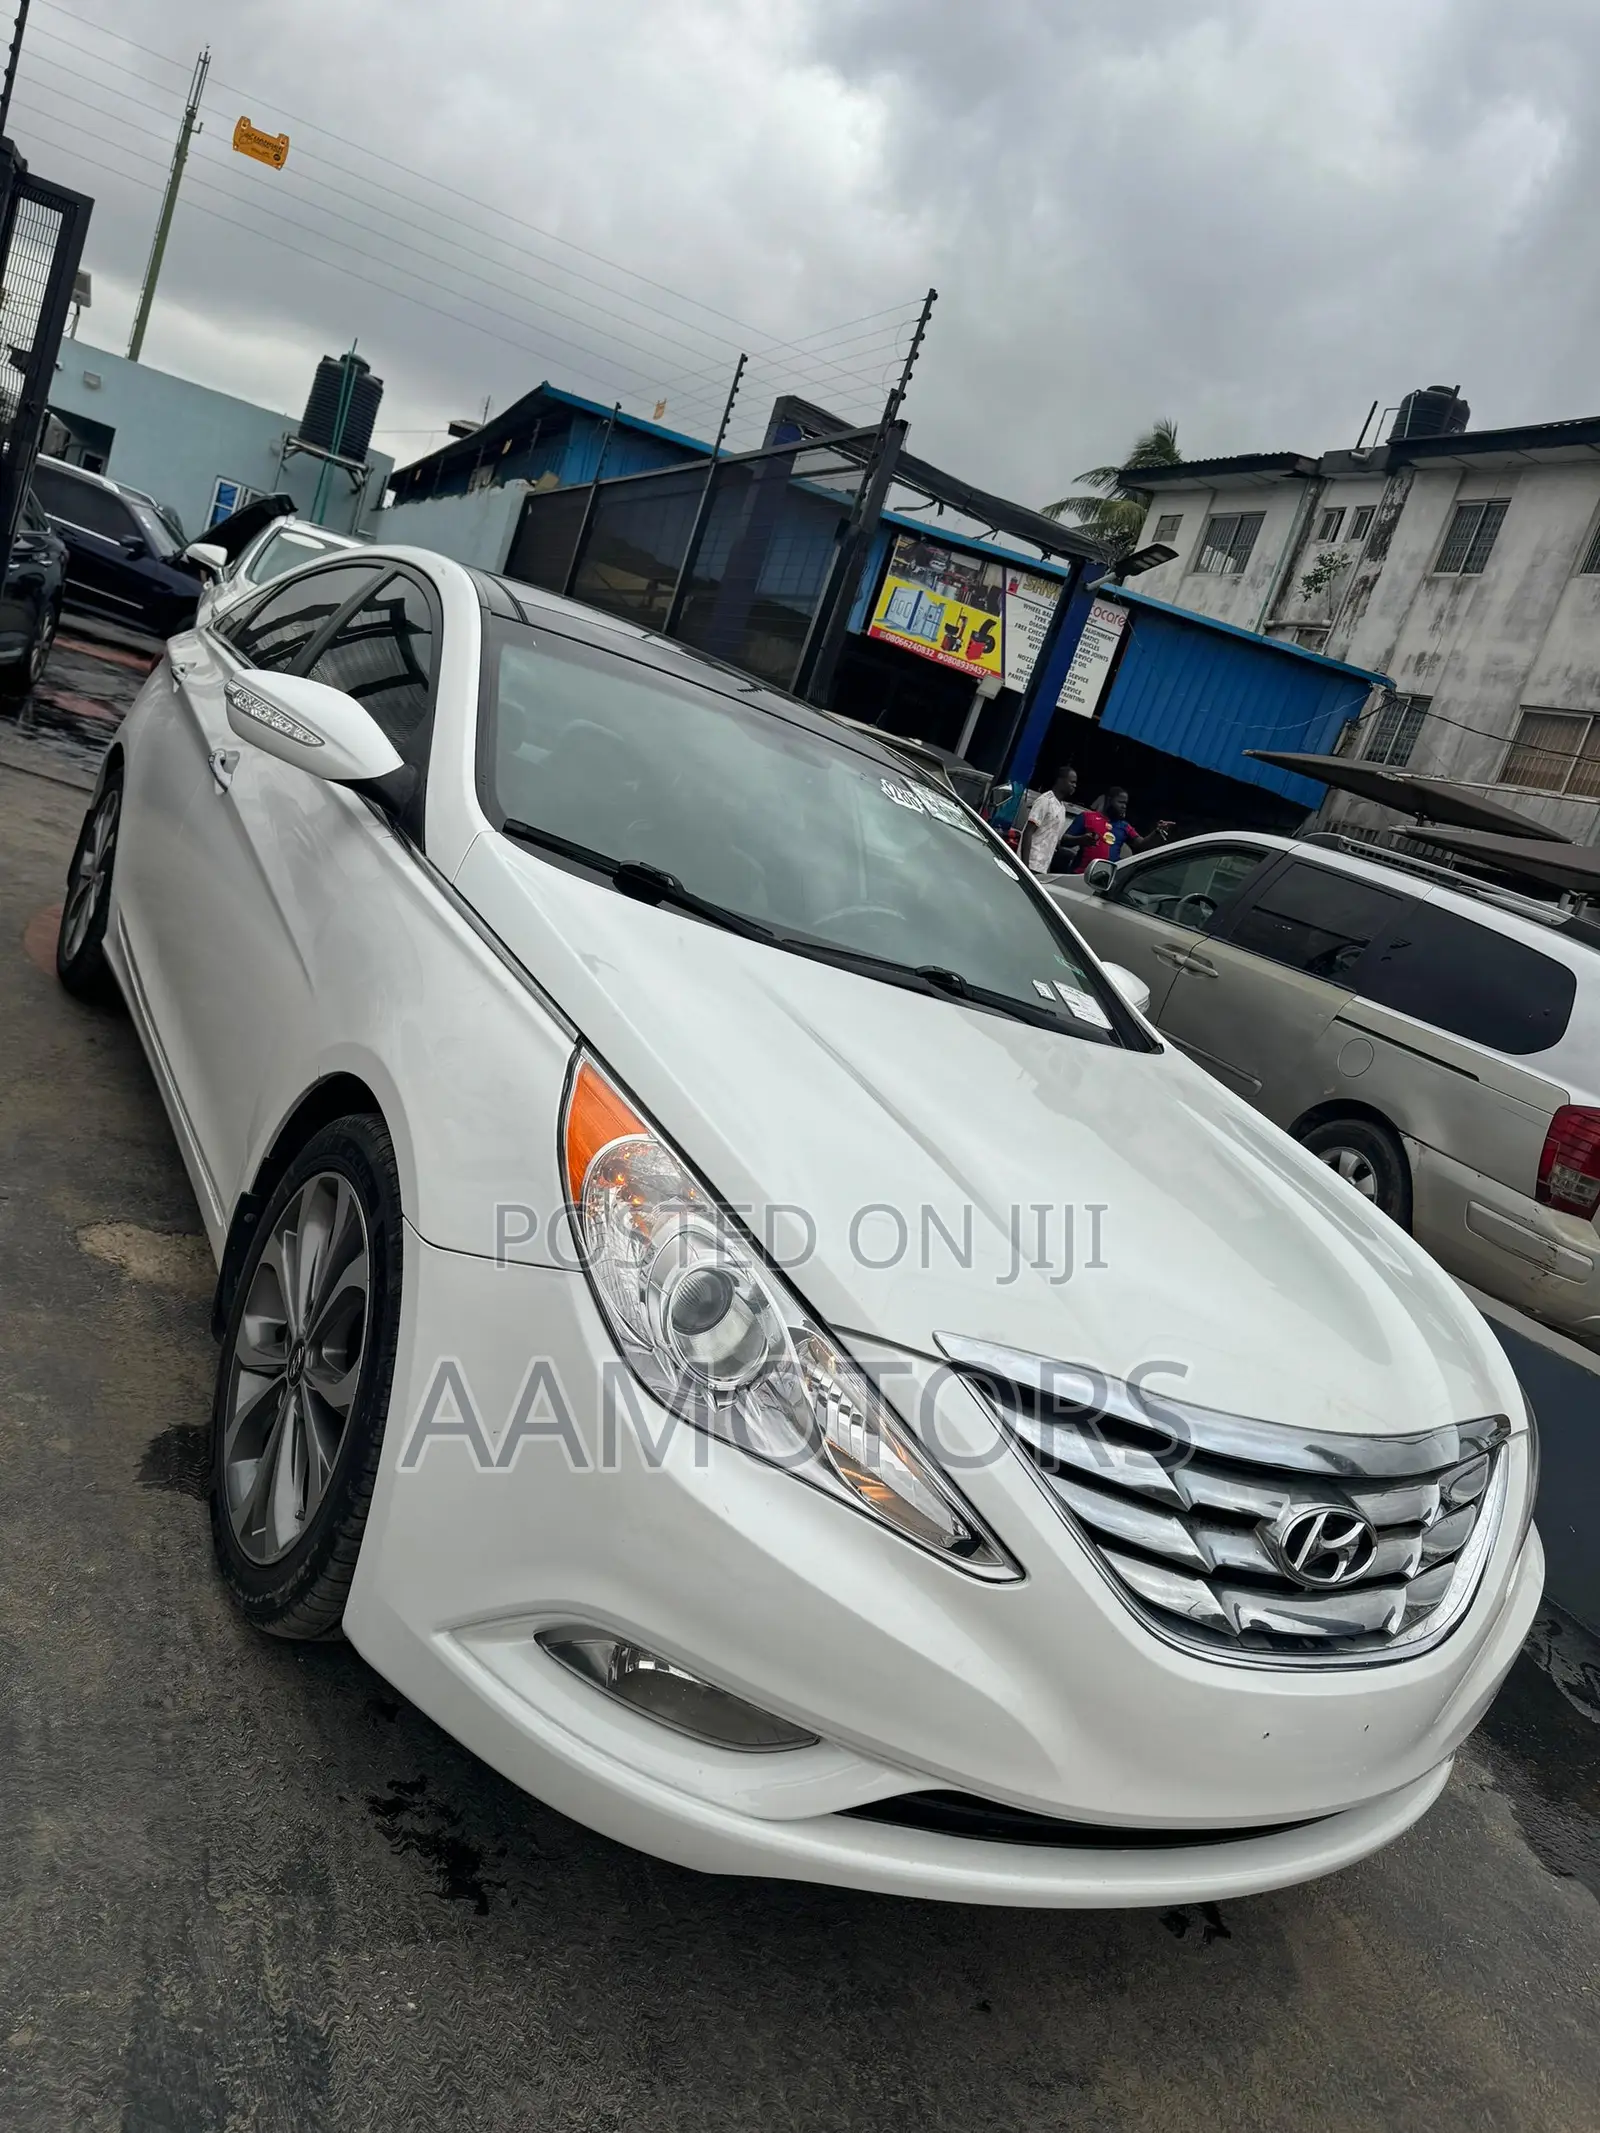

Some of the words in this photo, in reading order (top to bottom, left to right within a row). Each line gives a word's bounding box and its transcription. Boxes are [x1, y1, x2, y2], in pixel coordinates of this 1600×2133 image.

[1023, 575, 1059, 601] SHY
[1091, 604, 1126, 627] ocare
[1023, 603, 1041, 615] WHEEL
[1085, 627, 1115, 642] ALIGNMENT
[1014, 622, 1028, 632] FREE
[1079, 647, 1091, 656] ARM
[1091, 651, 1109, 663] JOINTS
[1080, 639, 1100, 652] EHICLES
[1017, 653, 1035, 664] NOZZL
[1068, 672, 1089, 684] SERVICE
[1075, 652, 1093, 664] ERVICE
[1008, 672, 1024, 683] PANEL
[1063, 684, 1082, 696] ERVICE
